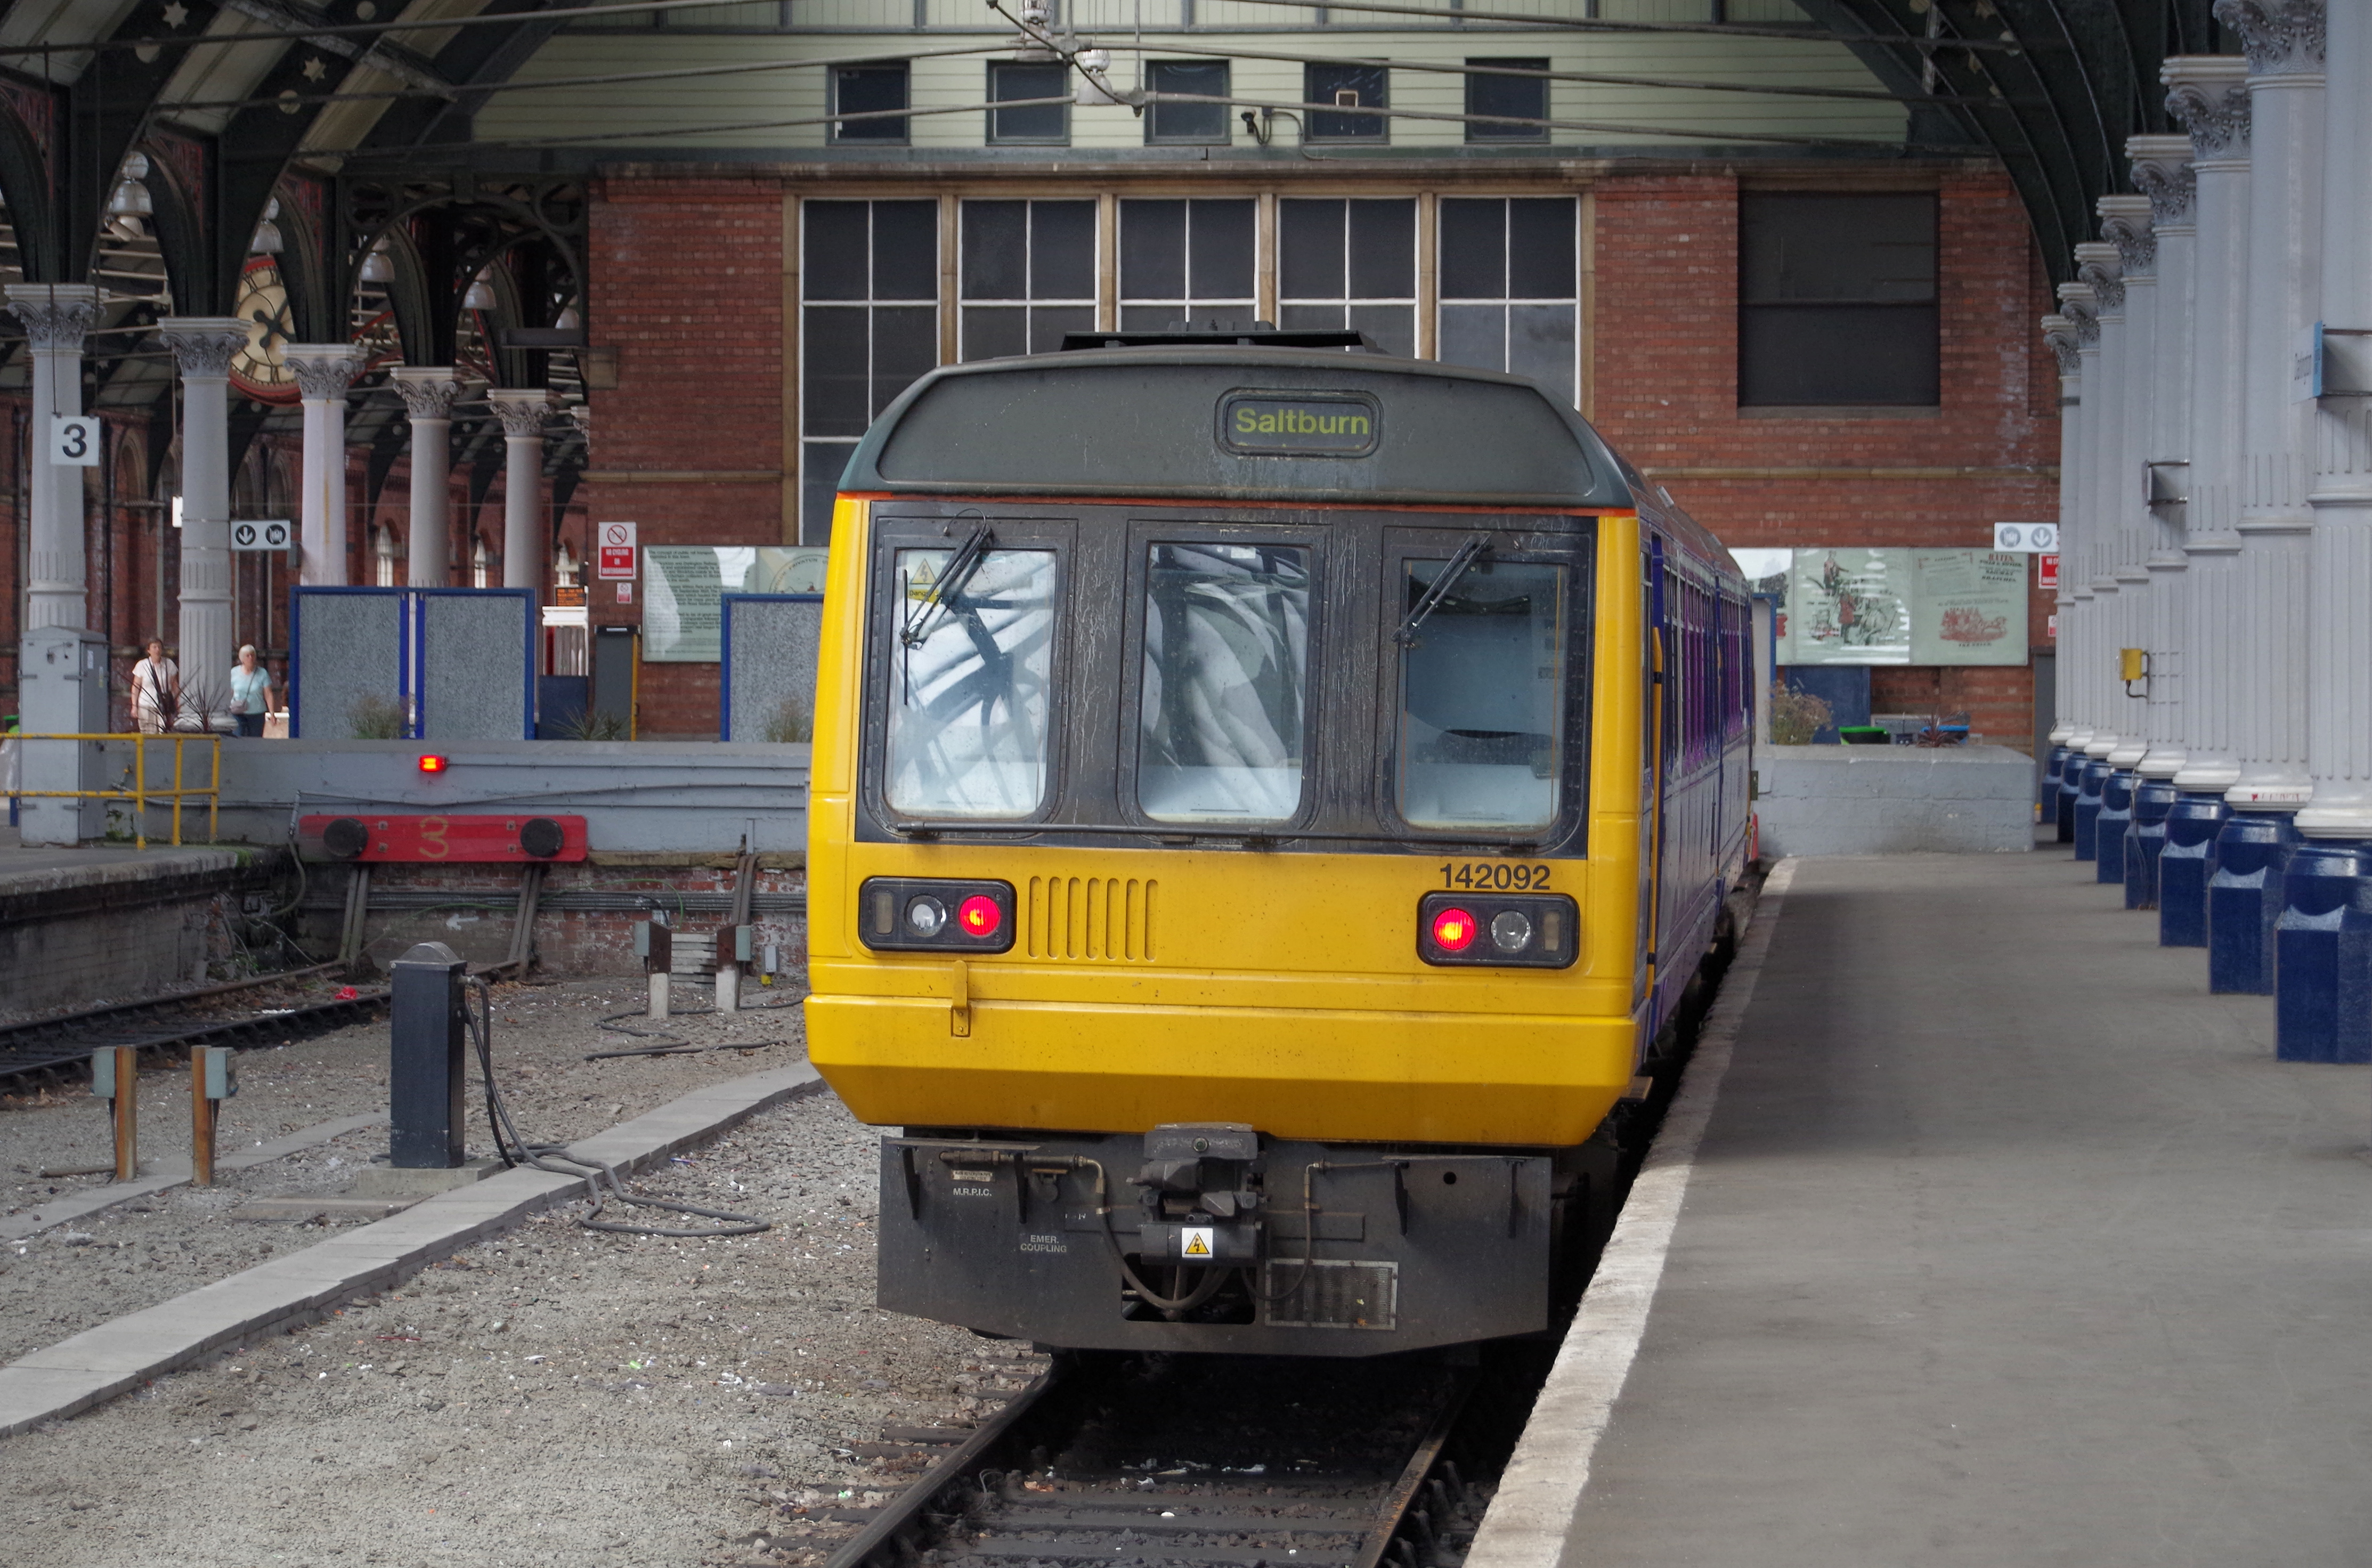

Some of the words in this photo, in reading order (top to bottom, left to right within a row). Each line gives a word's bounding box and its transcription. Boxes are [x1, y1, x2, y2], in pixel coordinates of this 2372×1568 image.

[1236, 407, 1368, 435] Saltburn
[62, 423, 87, 458] 3
[418, 815, 449, 859] 3
[1440, 863, 1550, 890] 142092
[953, 1188, 992, 1197] M.R.P.I.C.
[1020, 1243, 1067, 1253] COUPLING
[1030, 1234, 1059, 1244] EMER.
